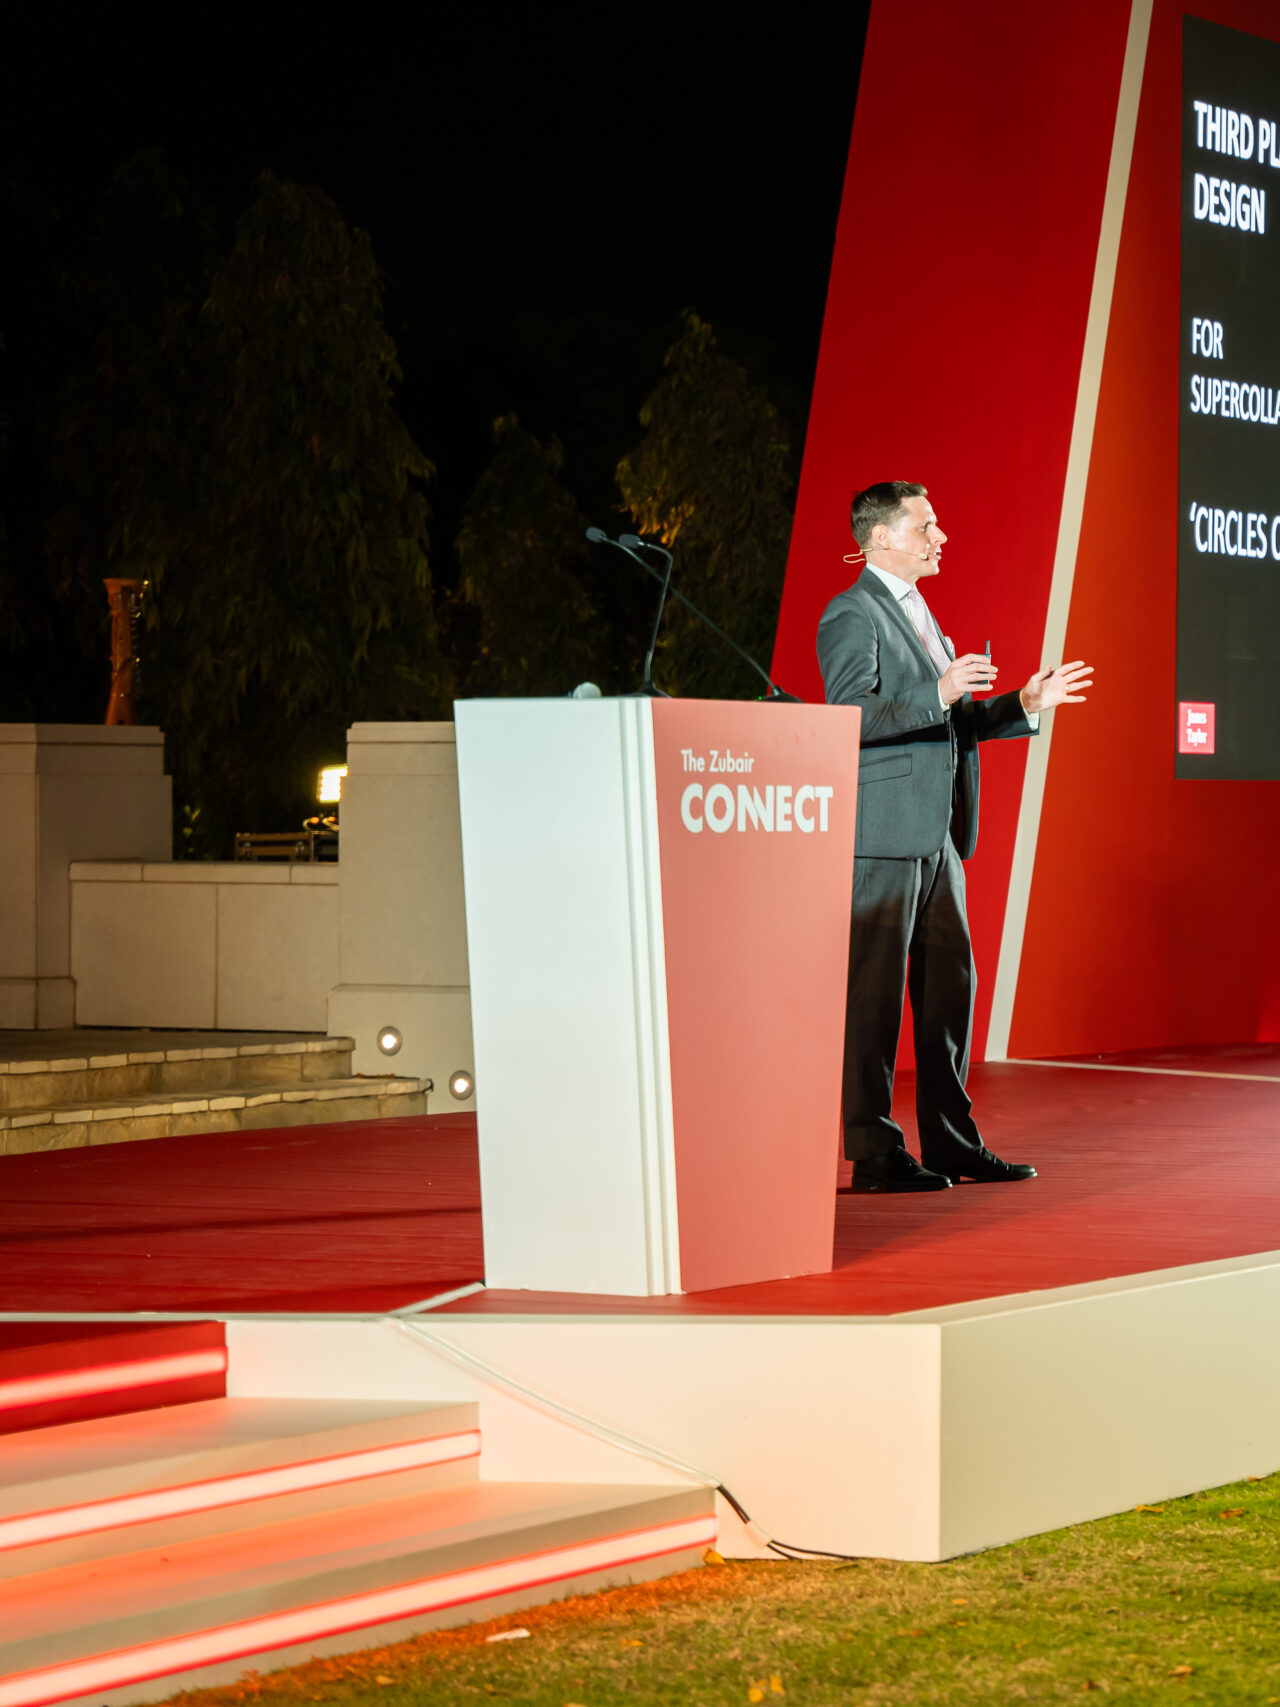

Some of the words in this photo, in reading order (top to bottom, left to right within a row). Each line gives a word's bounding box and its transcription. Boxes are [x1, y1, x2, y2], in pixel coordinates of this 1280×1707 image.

[1193, 100, 1254, 160] THIRD
[1193, 173, 1265, 235] DESIGN
[1192, 317, 1224, 359] FOR
[680, 748, 705, 772] The
[709, 749, 755, 773] Zubair
[680, 782, 834, 834] CONNECT
